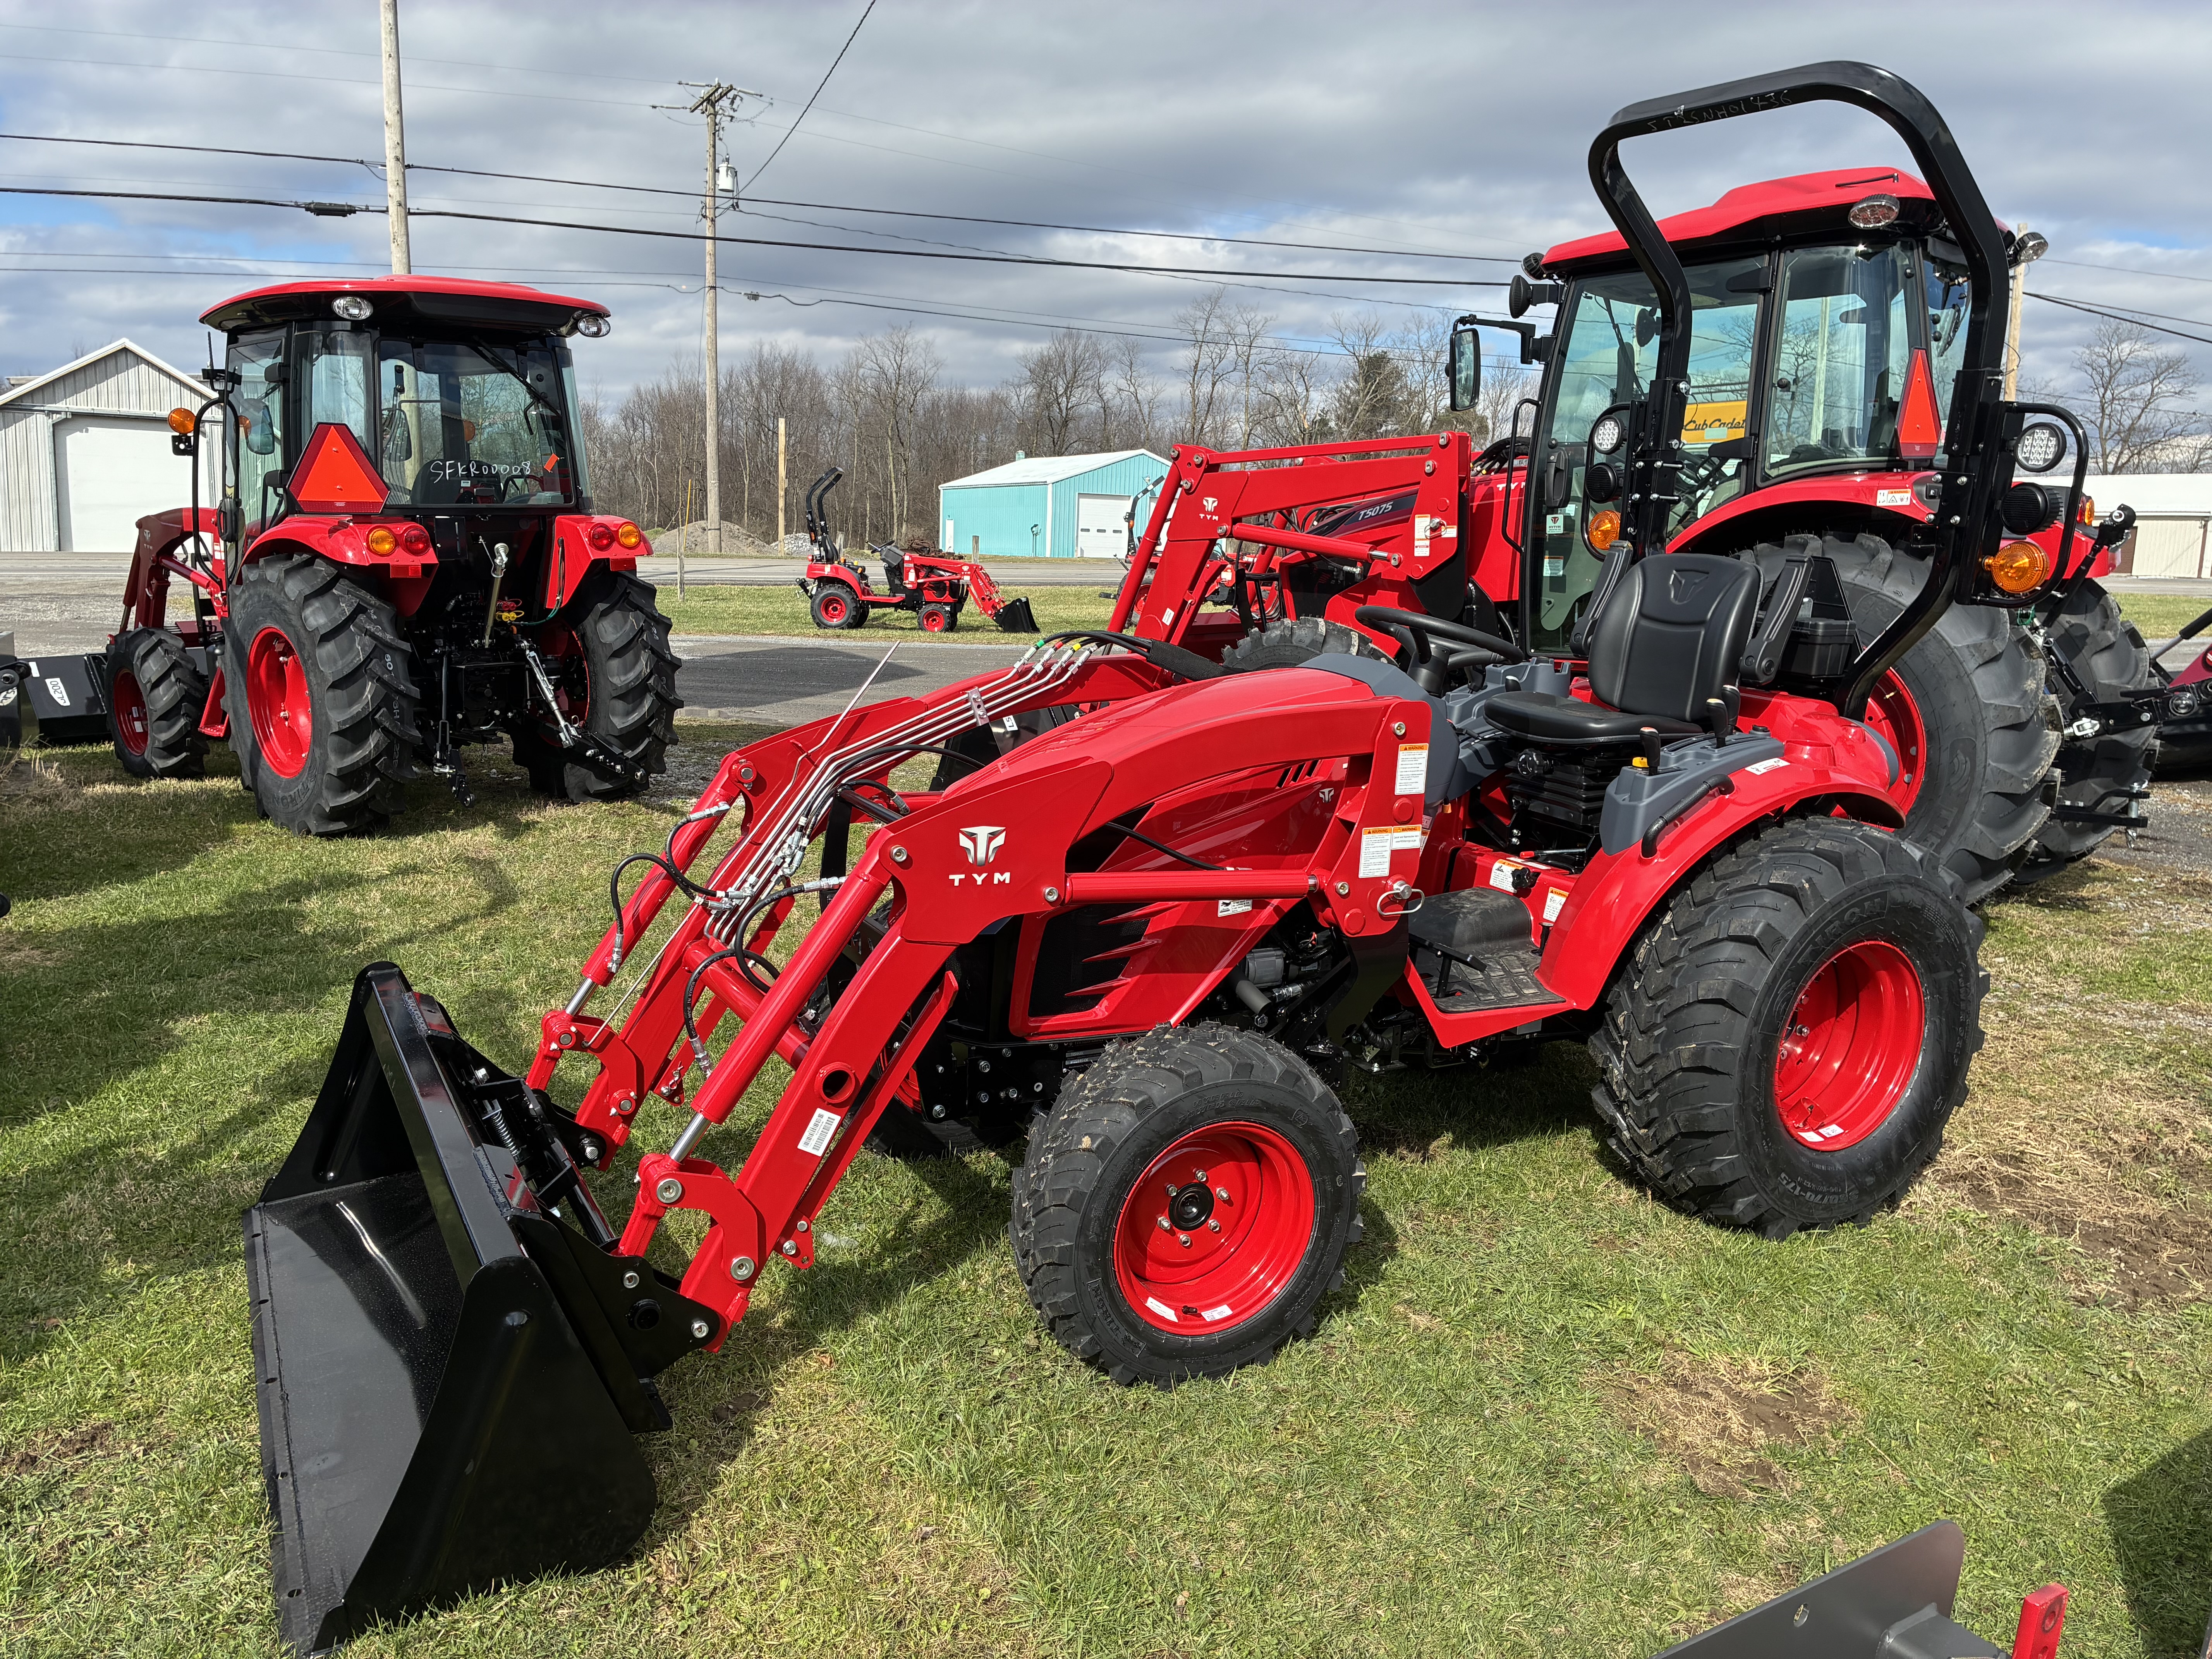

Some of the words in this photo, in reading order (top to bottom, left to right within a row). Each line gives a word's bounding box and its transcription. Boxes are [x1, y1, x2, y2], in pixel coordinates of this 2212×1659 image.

[1683, 419, 1708, 431] Cub
[1709, 418, 1746, 429] Cadet
[430, 460, 531, 484] SFKR00008
[1358, 501, 1394, 520] T5075
[1006, 717, 1014, 727] LS
[948, 872, 1010, 886] TYM
[1193, 1091, 1244, 1108] HYBRID
[1178, 1100, 1225, 1124] POWER
